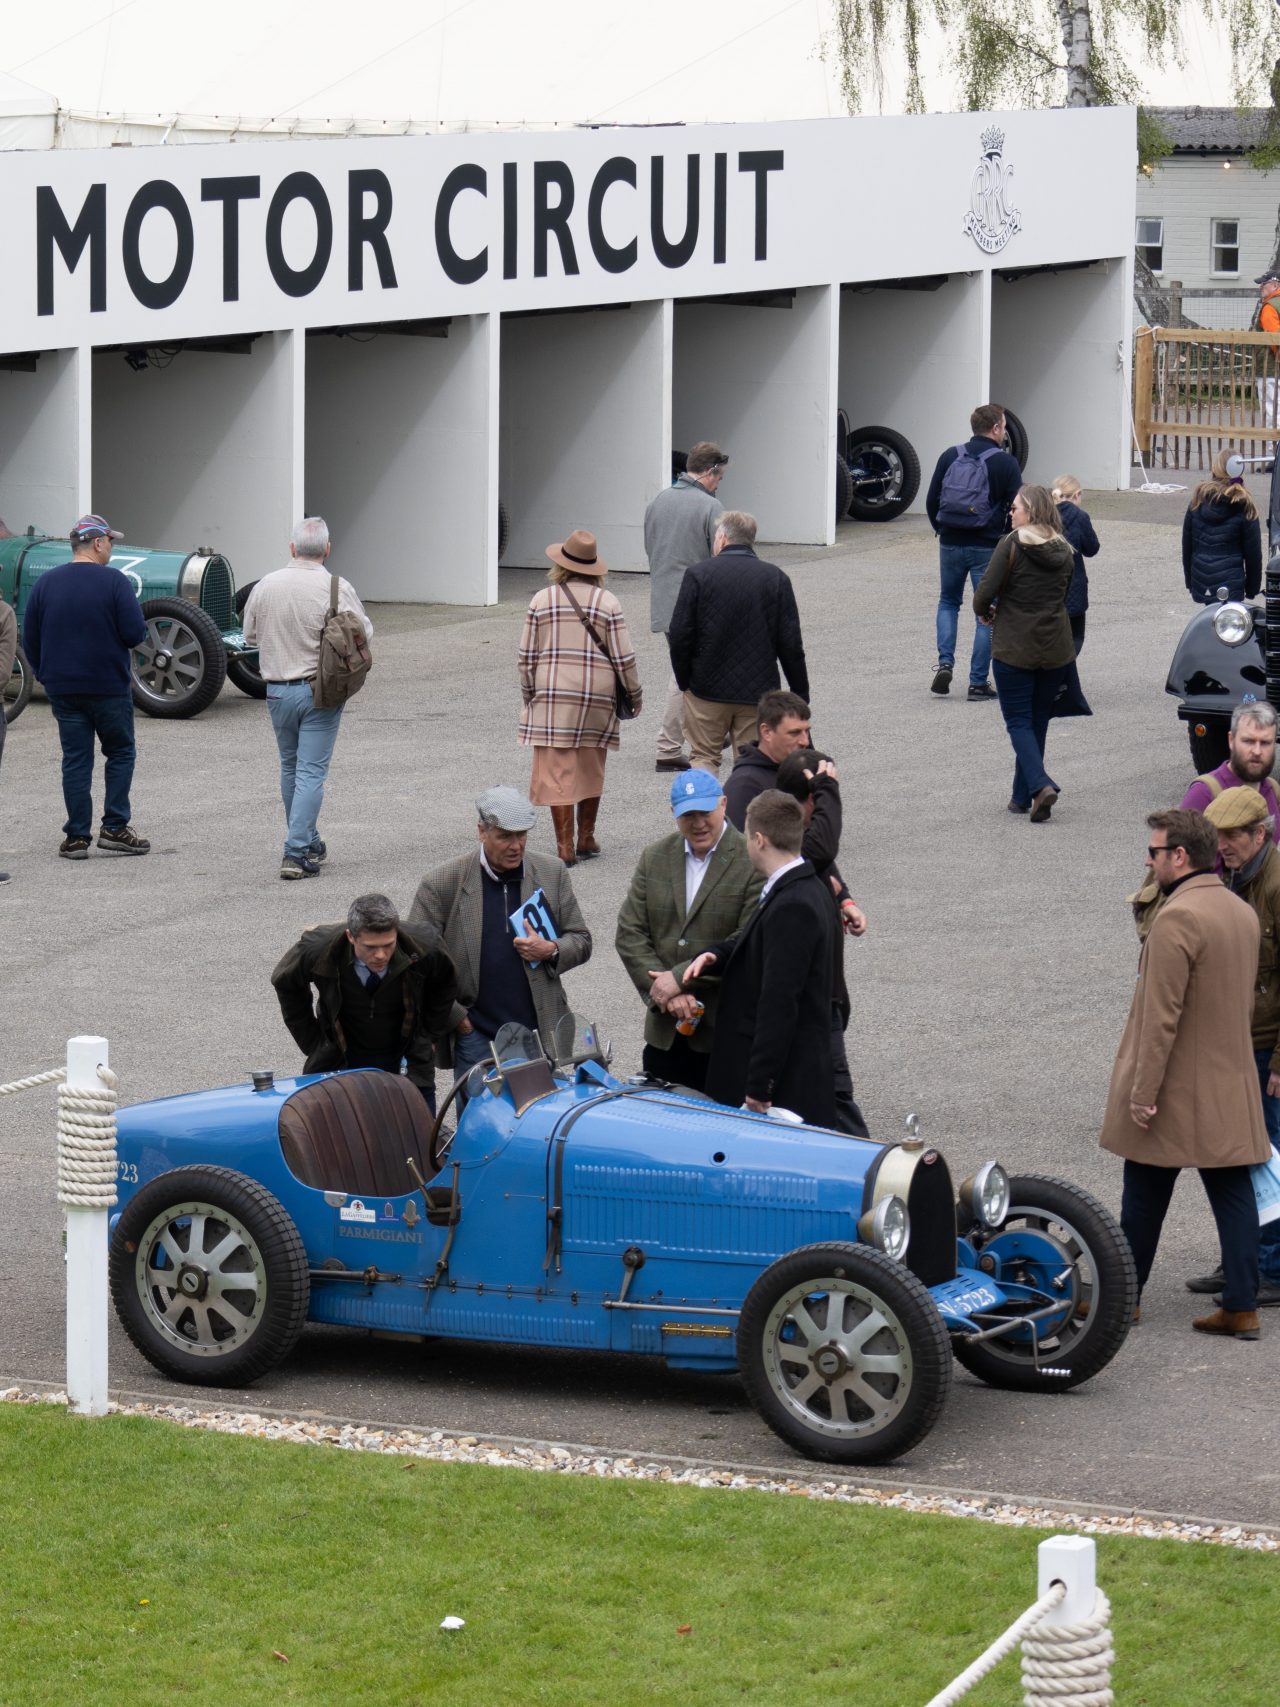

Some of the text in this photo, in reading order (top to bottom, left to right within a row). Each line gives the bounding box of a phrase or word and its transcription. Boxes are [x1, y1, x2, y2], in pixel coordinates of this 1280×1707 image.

[36, 168, 399, 317] MOTOR
[434, 149, 784, 285] CIRCUIT
[109, 555, 148, 598] 3
